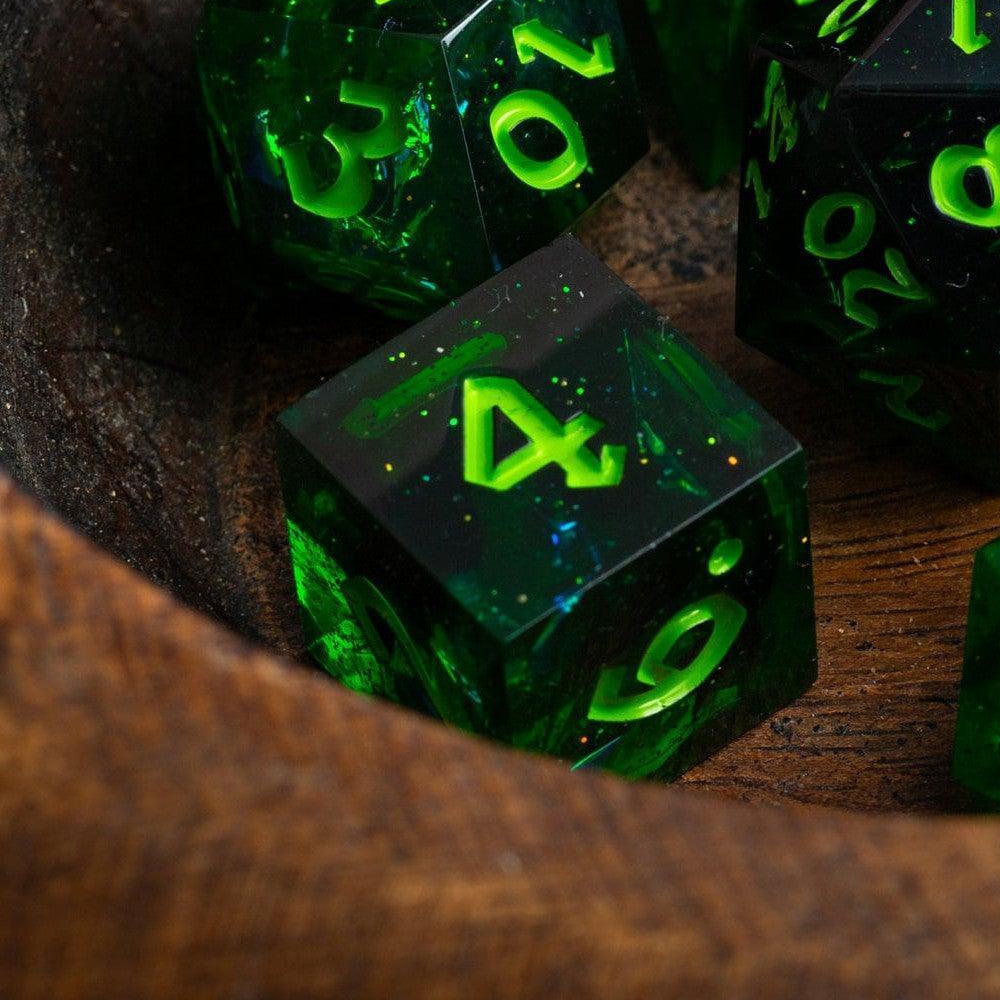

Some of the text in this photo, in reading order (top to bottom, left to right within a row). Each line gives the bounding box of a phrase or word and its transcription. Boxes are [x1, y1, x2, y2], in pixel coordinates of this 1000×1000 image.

[279, 78, 405, 220] 3
[489, 17, 616, 192] 10
[462, 374, 628, 492] 4
